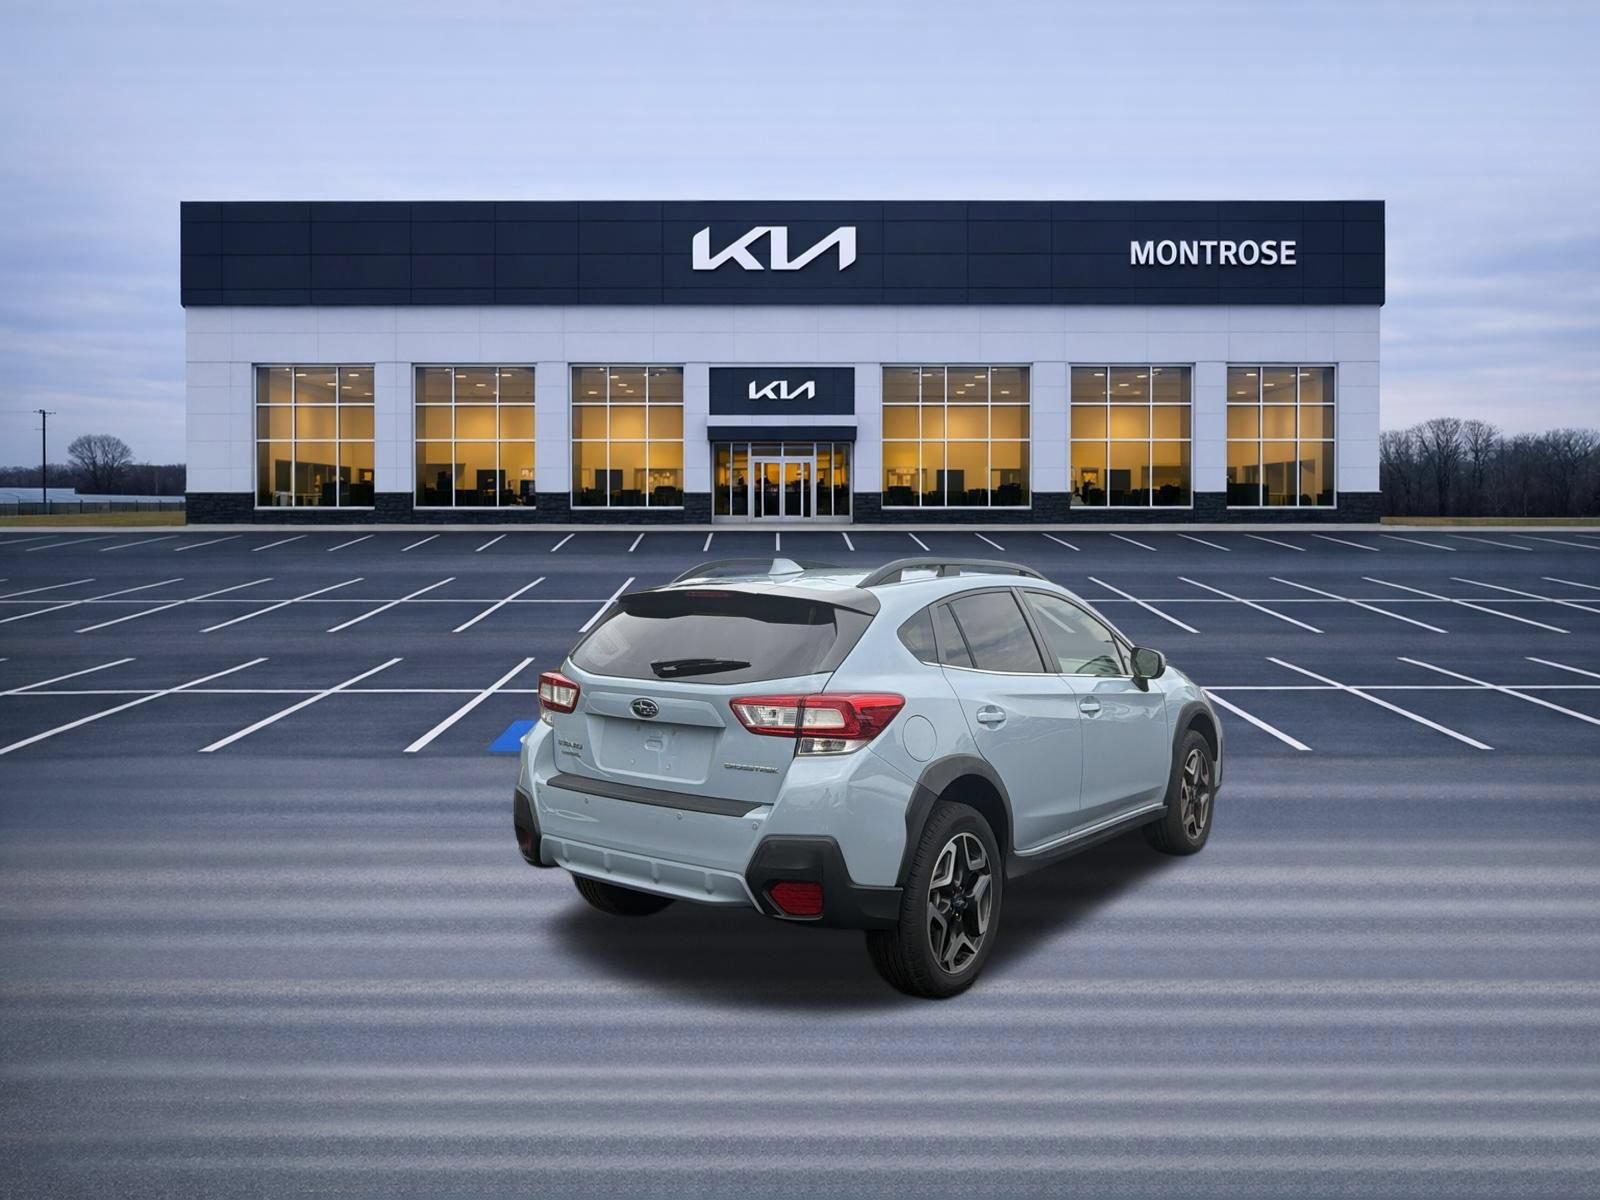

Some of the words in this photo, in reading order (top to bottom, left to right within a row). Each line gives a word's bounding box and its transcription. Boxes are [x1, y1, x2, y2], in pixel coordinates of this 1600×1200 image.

[692, 226, 857, 271] KIA
[1130, 240, 1297, 265] MONTROSE
[749, 380, 816, 400] KIA
